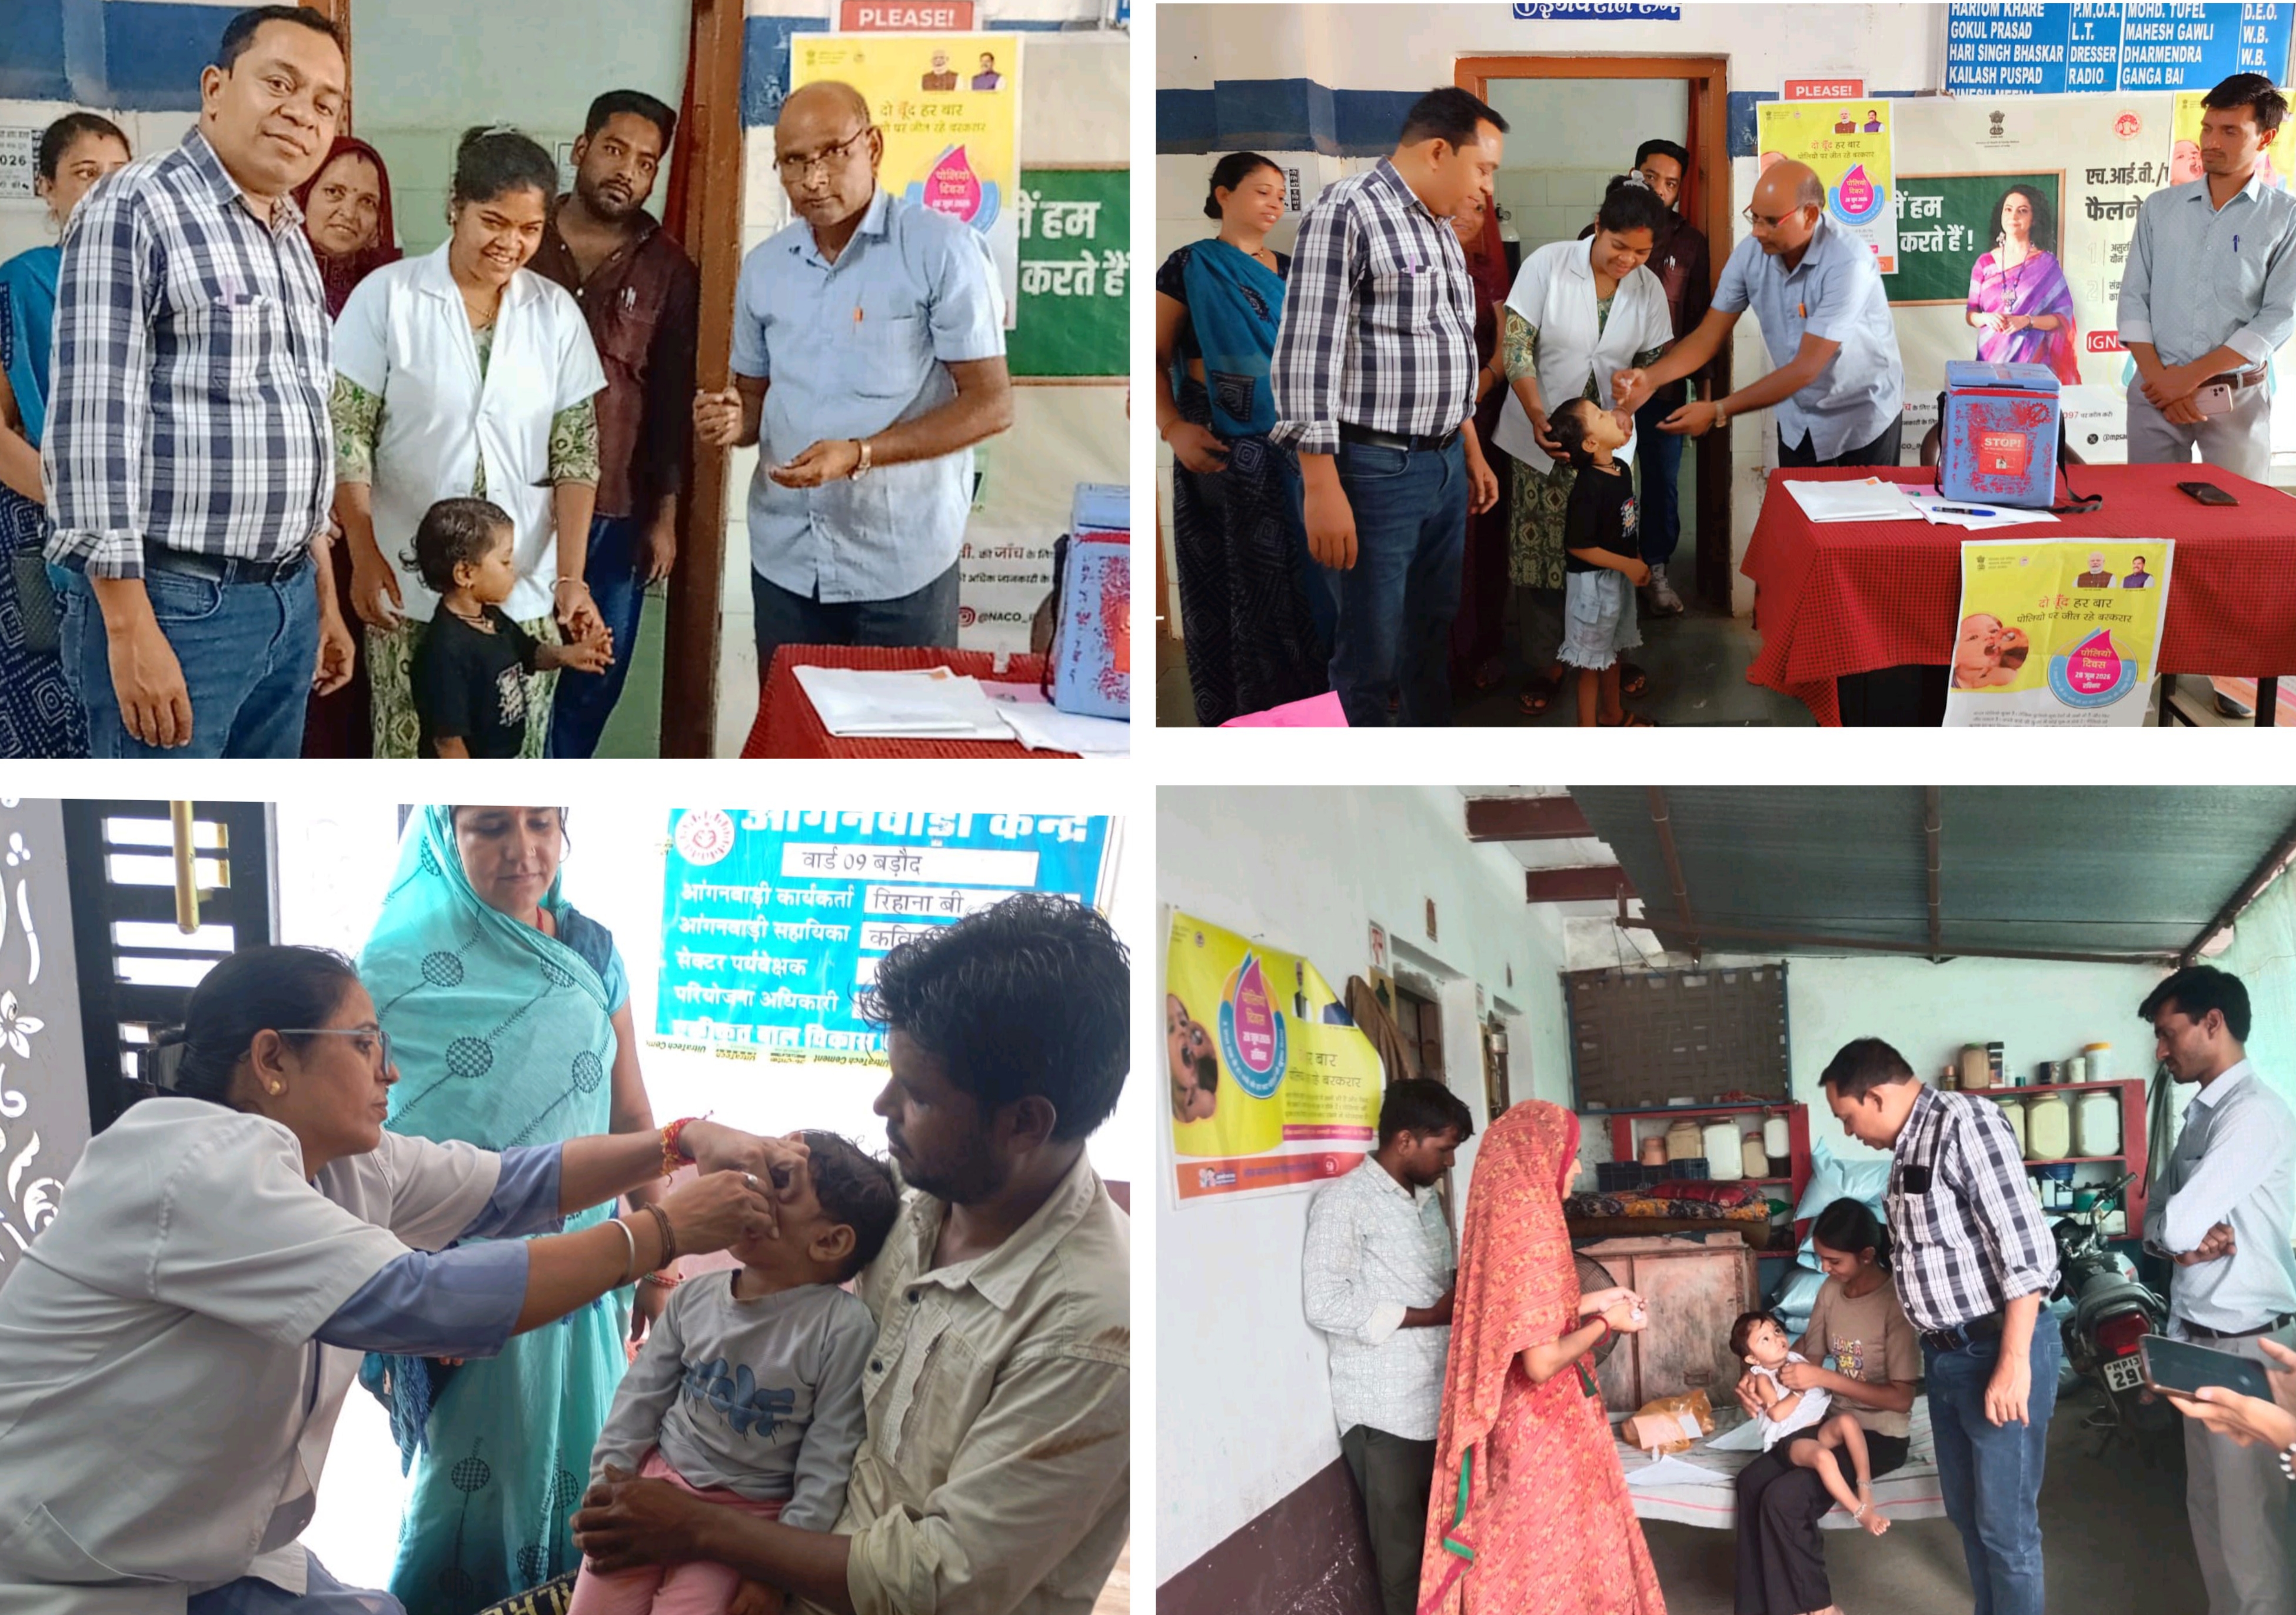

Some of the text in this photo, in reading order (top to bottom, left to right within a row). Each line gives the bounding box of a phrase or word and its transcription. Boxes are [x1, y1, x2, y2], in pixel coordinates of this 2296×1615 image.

[859, 8, 954, 26] PLEASE!
[1951, 3, 2044, 17] HARIOM KHARE
[2128, 3, 2205, 18] MOHD. TUFEL
[2245, 4, 2277, 20] D.E.O.
[1951, 21, 2032, 39] GOKUL PRASAD
[2072, 22, 2094, 40] L.T.
[2126, 24, 2214, 40] MAHESH GAWLI
[2243, 26, 2268, 44] W.B.
[1949, 44, 2064, 62] HARI SINGH BHASKAR
[2070, 46, 2116, 62] DRESSER
[2124, 46, 2202, 63] DHARMENDRA
[2241, 48, 2266, 66] W.B.
[1949, 66, 2042, 84] KAILASH PUSPAD
[2069, 68, 2104, 84] RADIO
[2122, 68, 2184, 85] GANGA BAI
[1795, 86, 1852, 96] PLEASE!
[921, 104, 937, 116] हर
[1908, 197, 1944, 219] हम
[1040, 201, 1101, 239] हम
[1899, 225, 1945, 252] करते
[1946, 224, 1965, 251] हैं
[1021, 249, 1100, 296] करते
[1984, 438, 2021, 448] STOP!
[2039, 596, 2049, 608] दो
[2074, 598, 2089, 608] हर
[2093, 598, 2113, 608] बार
[2017, 612, 2045, 622] पोलियो
[2062, 611, 2080, 621] जीत
[2084, 611, 2095, 621] रहे
[2098, 613, 2132, 622] बरकरार
[2081, 647, 2112, 658] पोलियो
[2082, 657, 2107, 669] दिवस
[802, 846, 923, 877] वार्ड 09 बड़ौद
[680, 878, 965, 915] आंगनवाड़ी कार्यकर्ता रिहाना बी
[678, 913, 769, 943] आंगनवाड़ी
[869, 924, 924, 947] कवि
[673, 981, 840, 1011] परियोजना अधिकारी
[668, 1043, 706, 1053] UltraTech
[813, 1054, 847, 1064] Cement
[1315, 1053, 1338, 1067] बार
[1323, 1075, 1361, 1088] बरकरार
[2112, 1357, 2139, 1371] MP13
